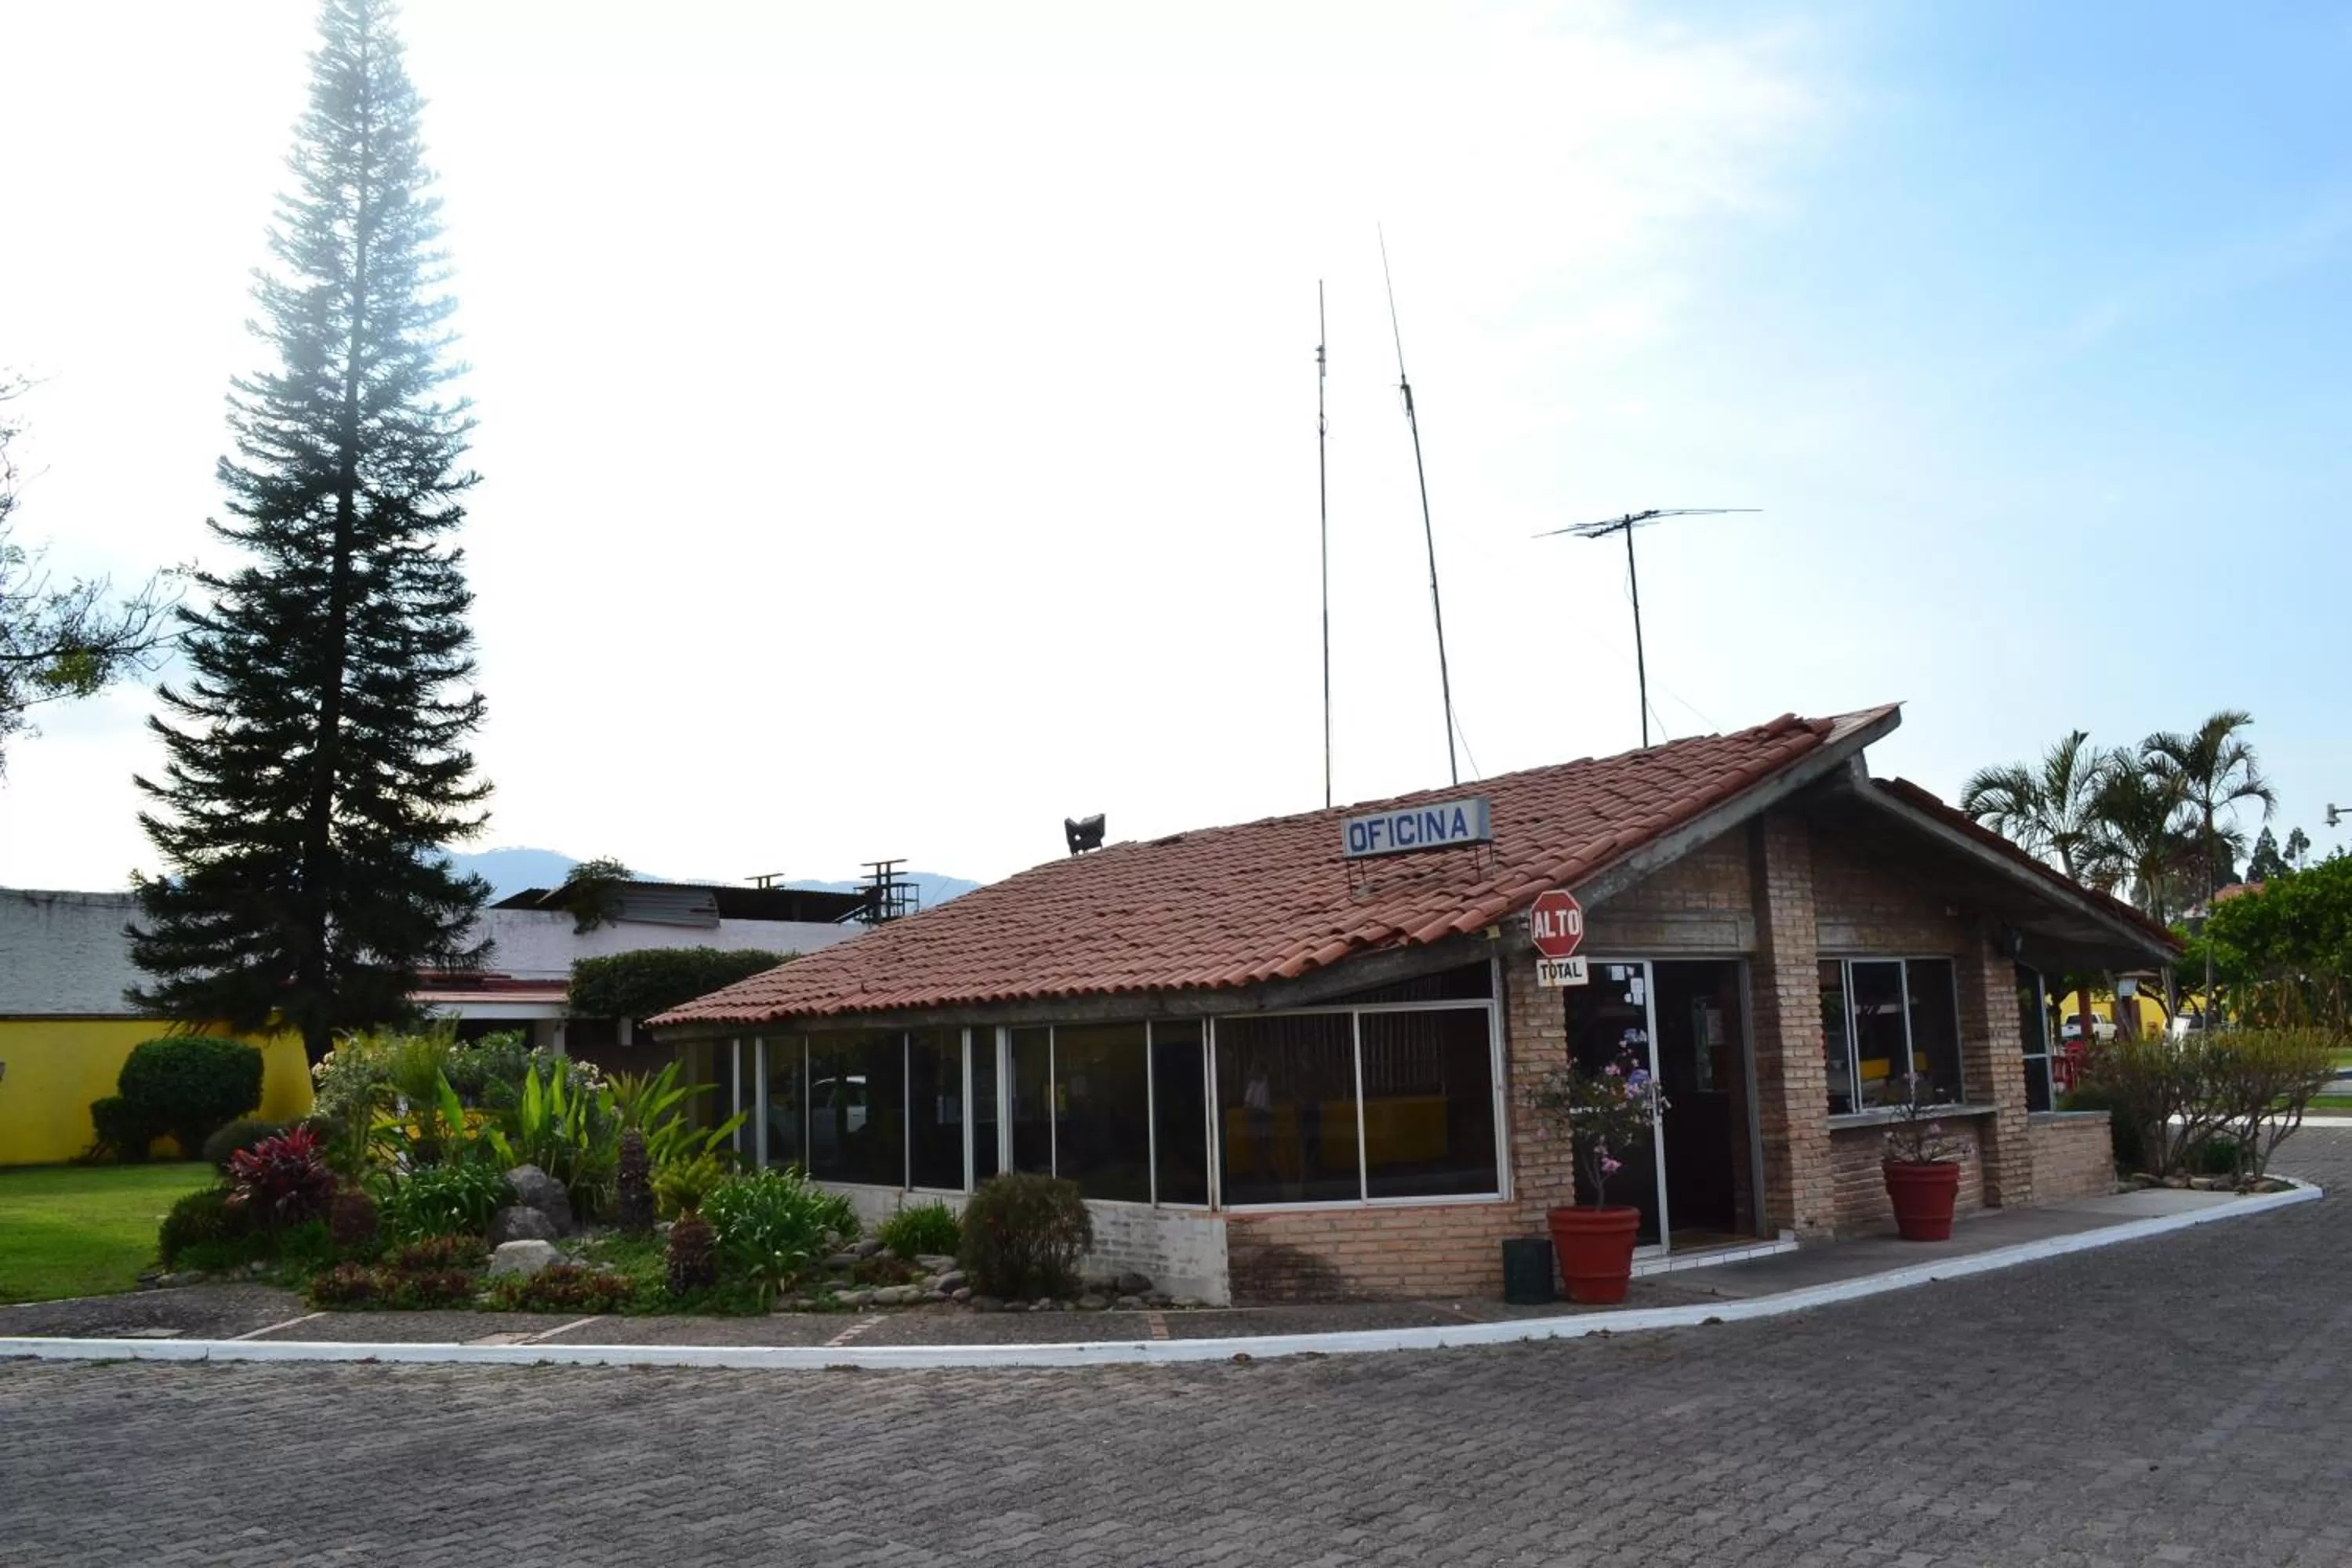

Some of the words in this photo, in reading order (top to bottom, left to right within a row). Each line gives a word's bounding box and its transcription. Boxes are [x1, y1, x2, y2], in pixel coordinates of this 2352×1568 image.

[1349, 808, 1468, 851] OFICINA
[1535, 909, 1580, 938] ALTO
[1541, 963, 1582, 979] TOTAL
